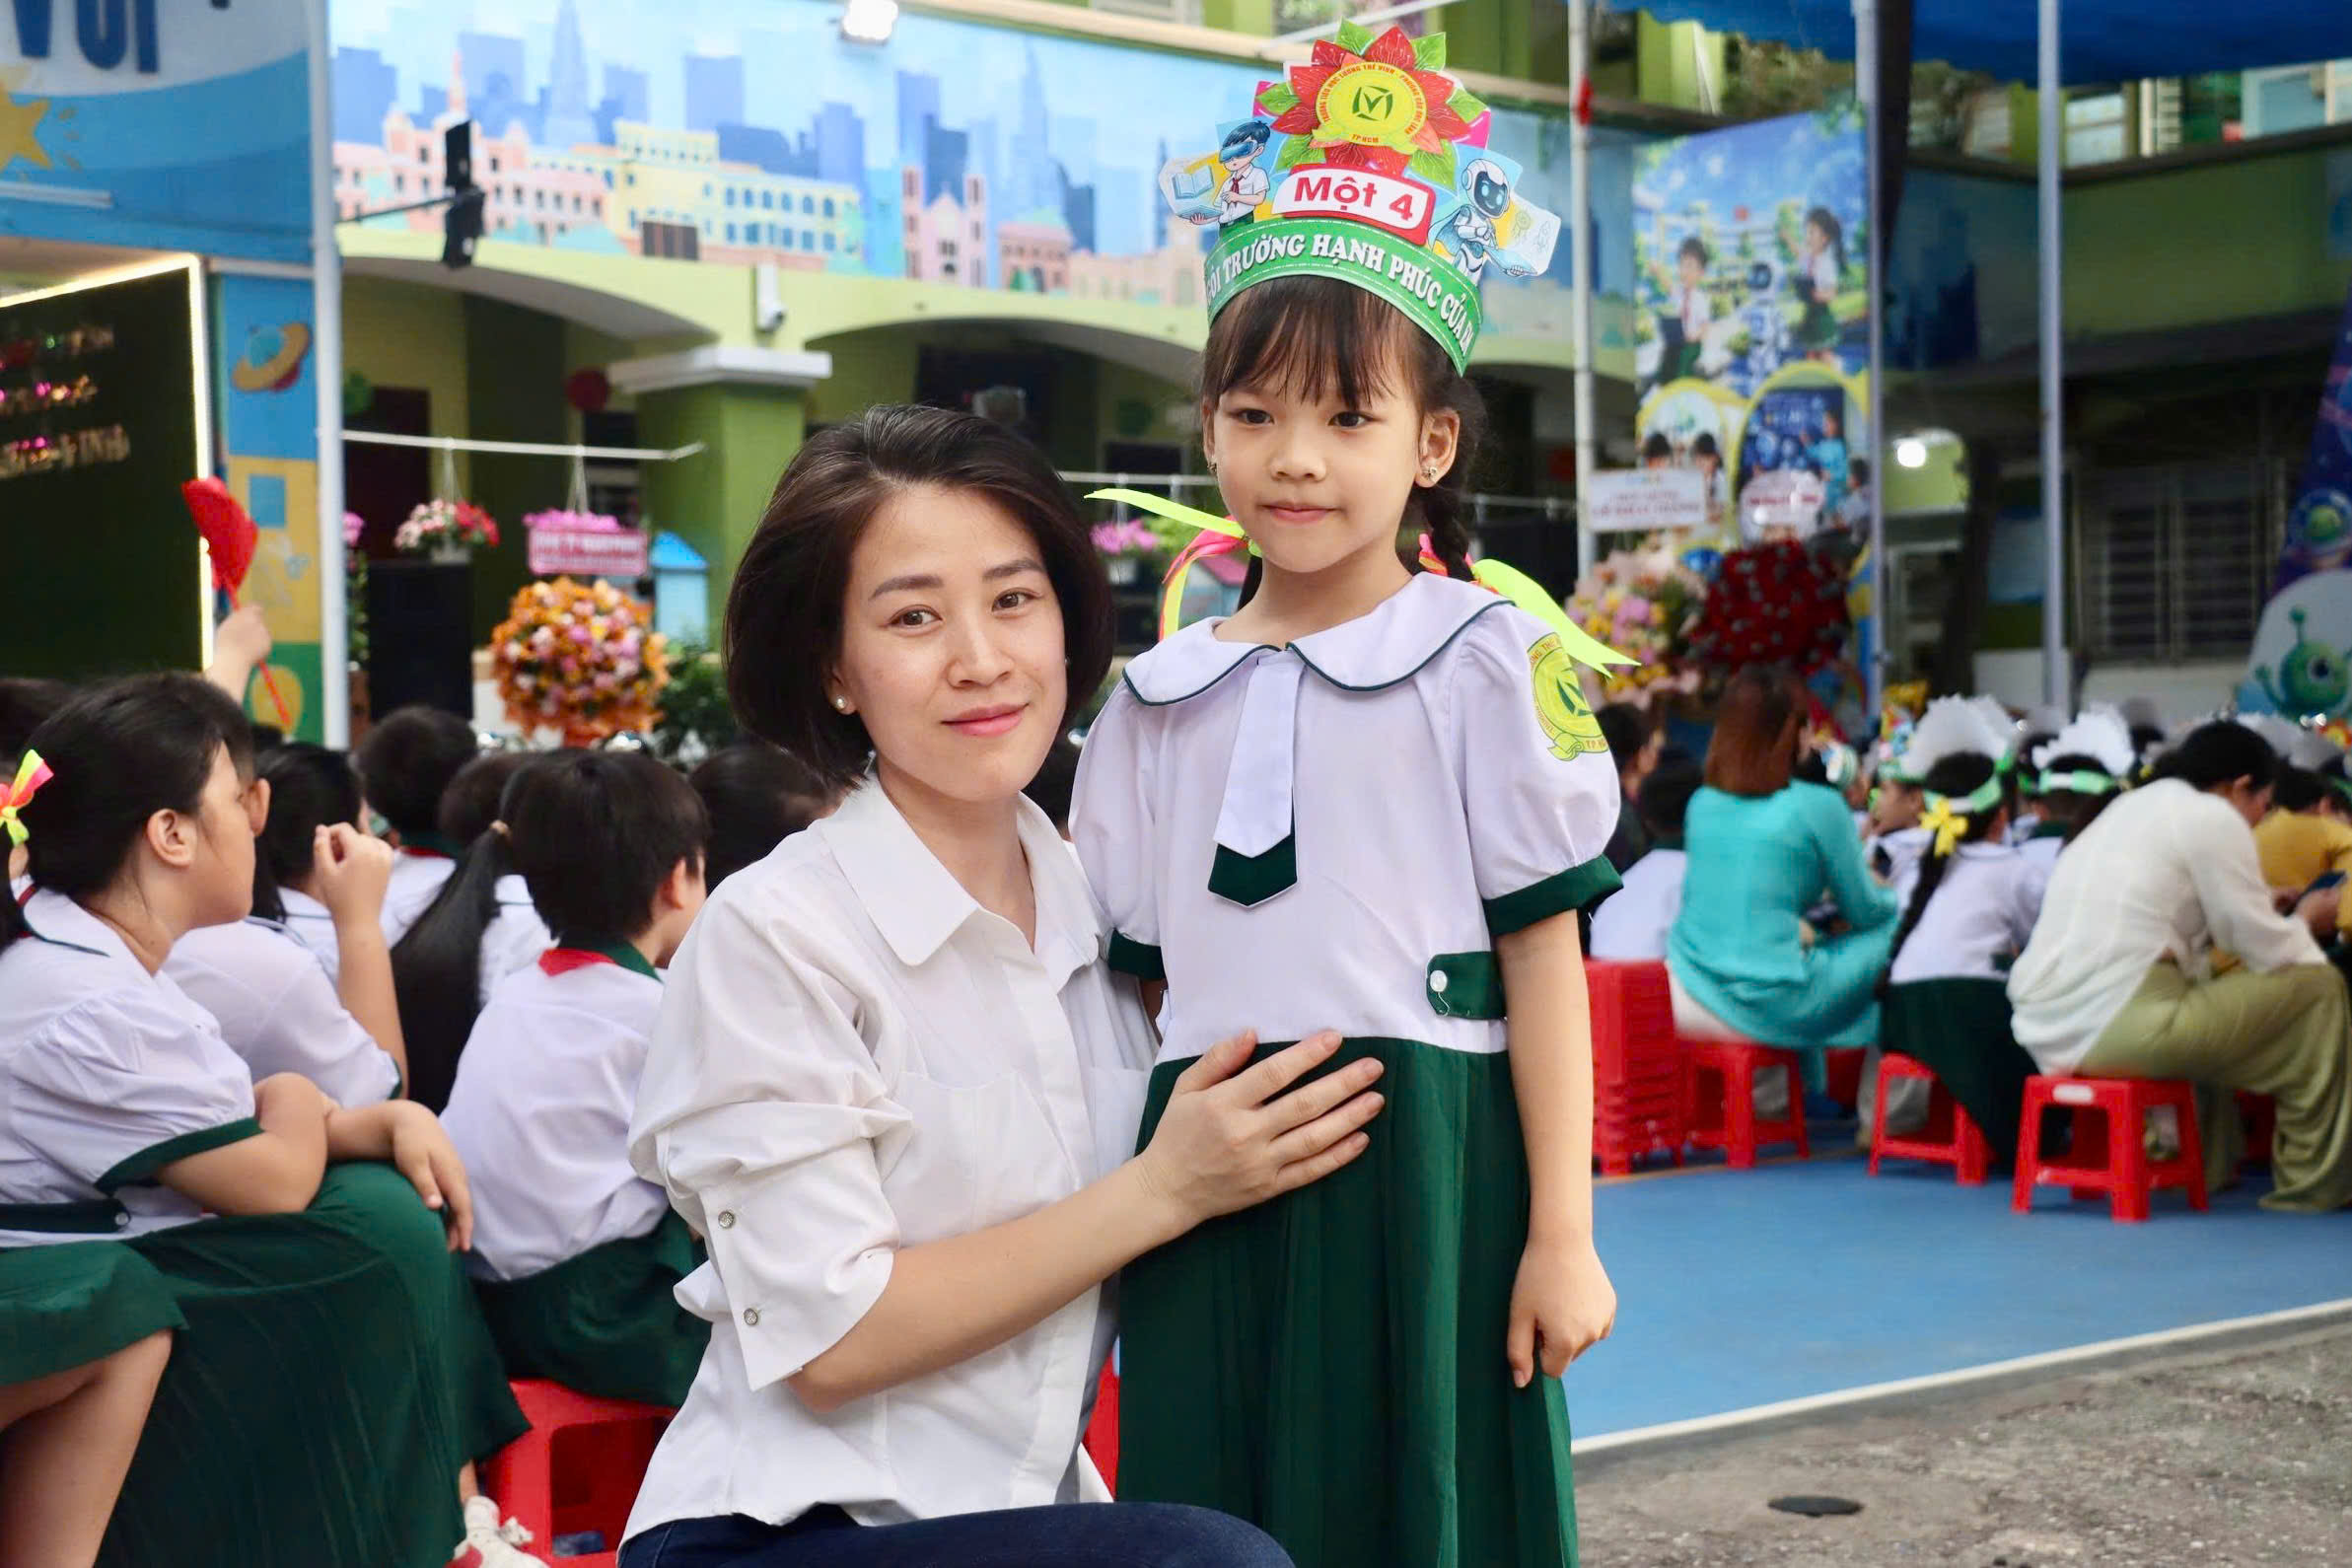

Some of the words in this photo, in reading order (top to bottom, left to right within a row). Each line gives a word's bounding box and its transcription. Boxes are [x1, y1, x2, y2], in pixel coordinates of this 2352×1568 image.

[1294, 176, 1378, 211] Một
[1389, 193, 1413, 221] 4
[1222, 234, 1306, 285] TRƯỜNG
[1310, 234, 1387, 273] HẠNH
[1388, 253, 1443, 309] PHÚC
[1441, 292, 1467, 340] CỦA
